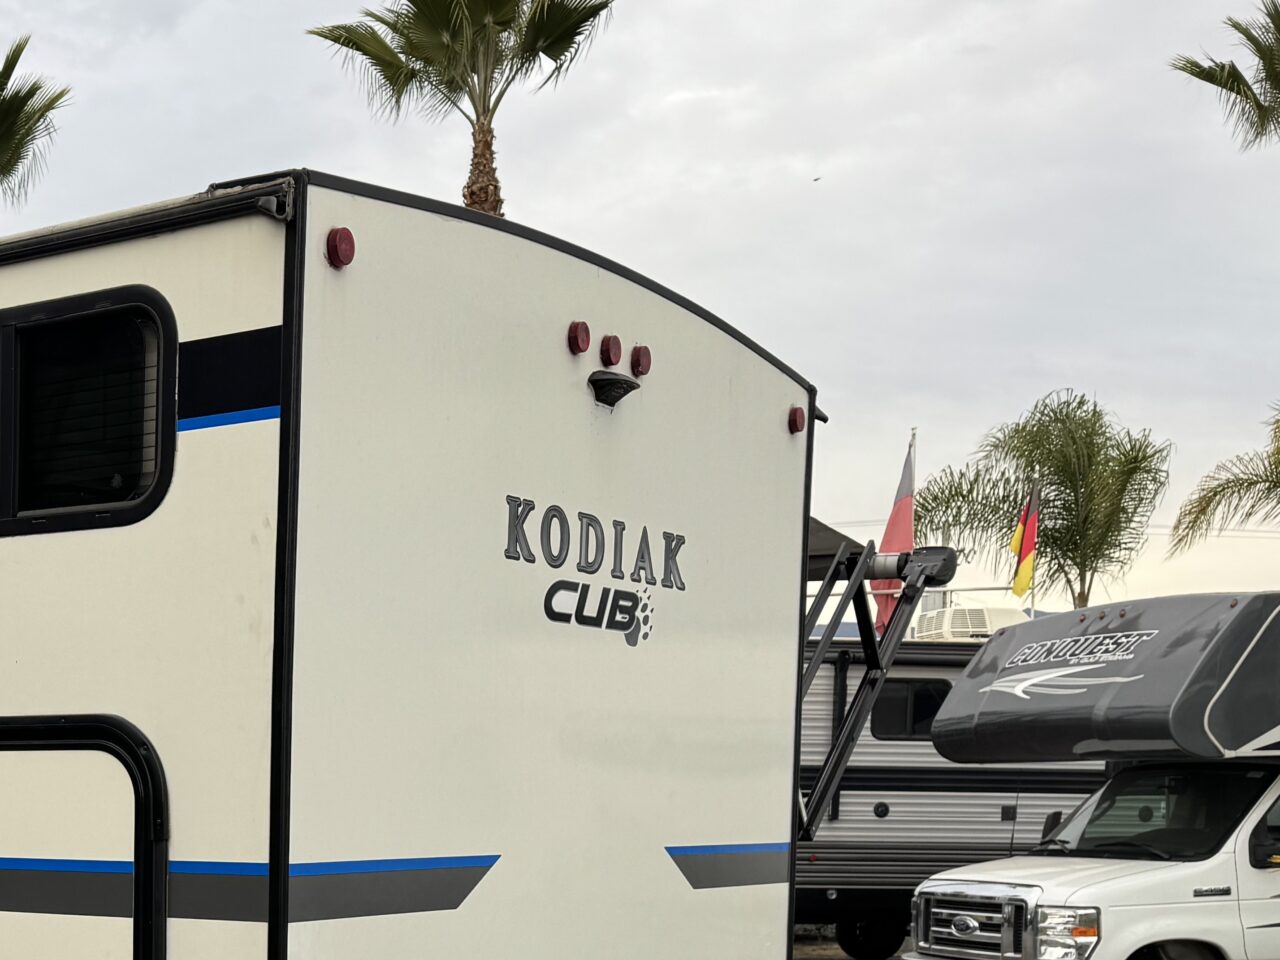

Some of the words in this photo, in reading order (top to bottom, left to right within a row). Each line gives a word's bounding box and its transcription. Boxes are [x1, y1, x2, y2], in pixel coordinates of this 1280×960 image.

[504, 494, 686, 592] KODIAK
[543, 579, 641, 633] CUB
[1006, 630, 1160, 668] CONQUEST
